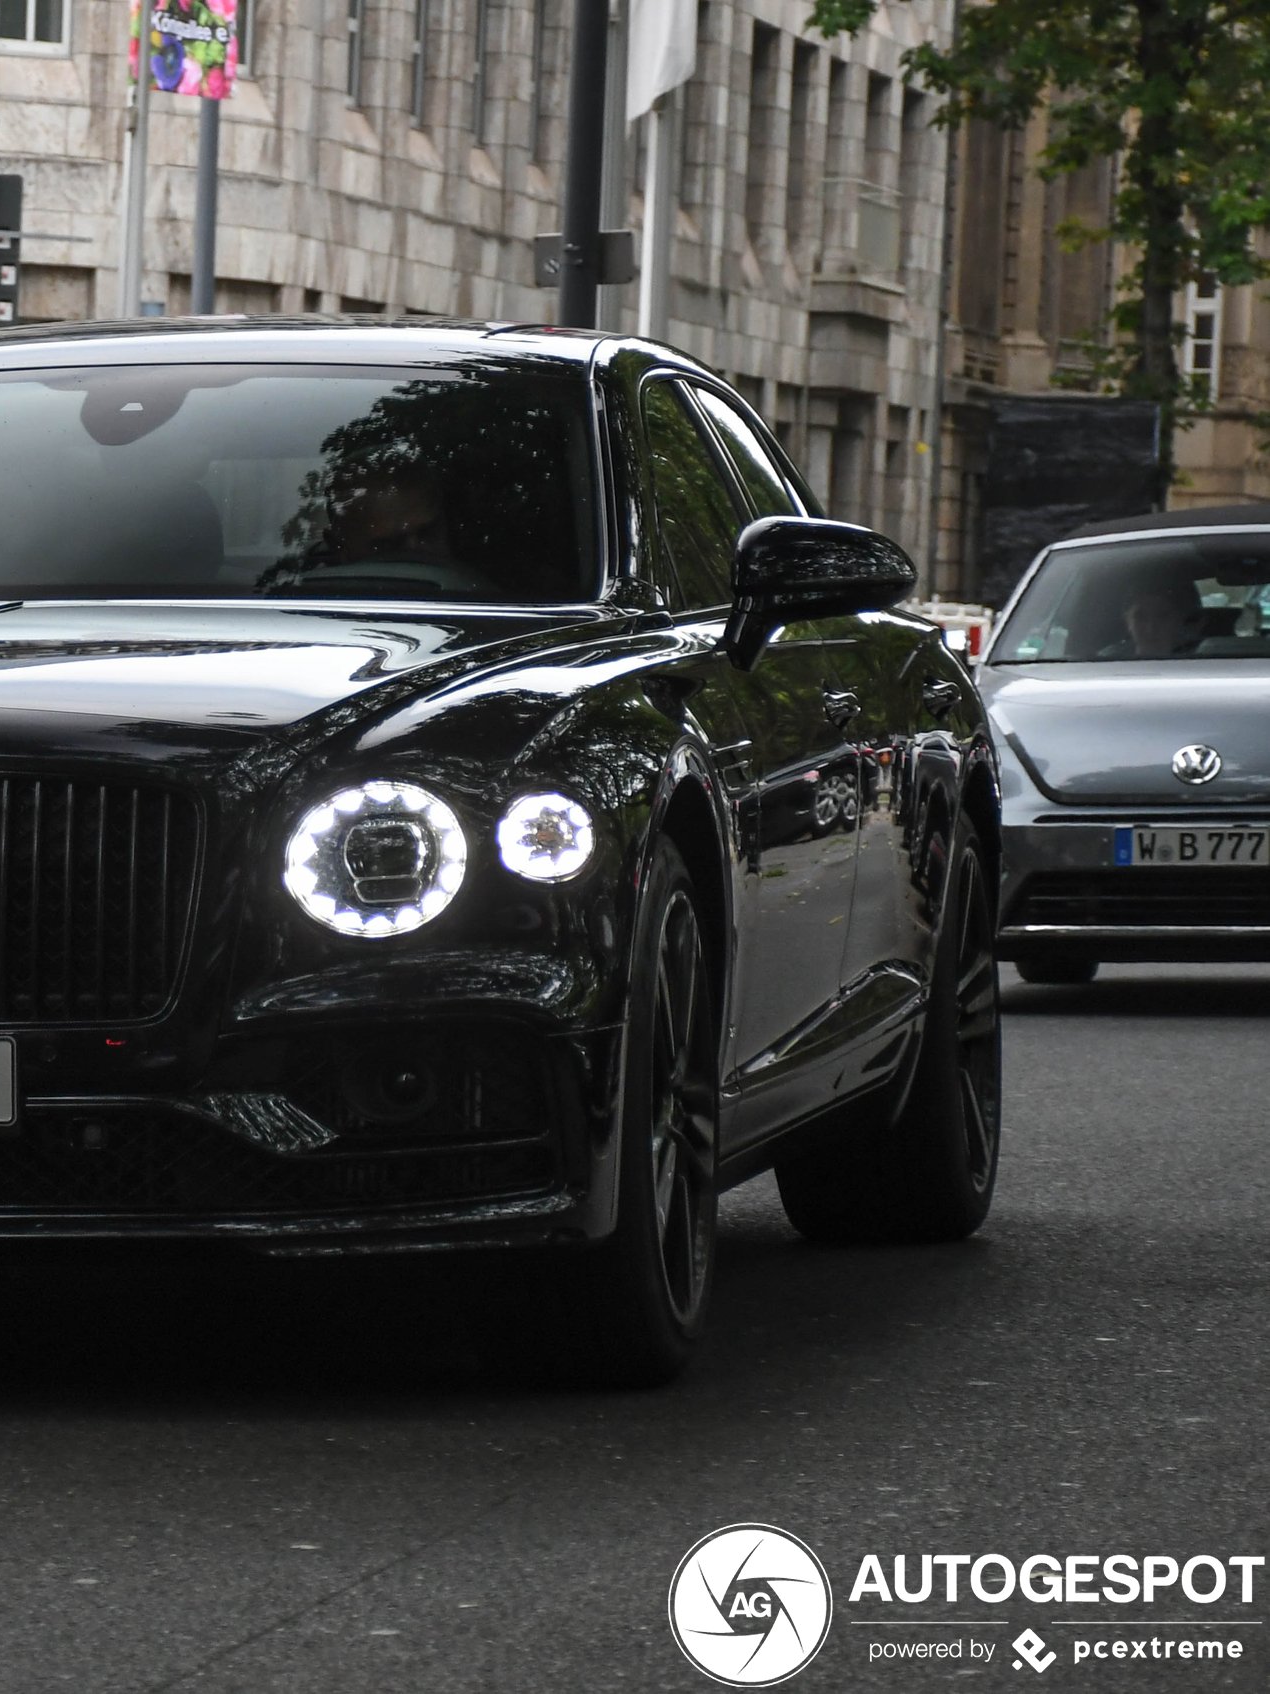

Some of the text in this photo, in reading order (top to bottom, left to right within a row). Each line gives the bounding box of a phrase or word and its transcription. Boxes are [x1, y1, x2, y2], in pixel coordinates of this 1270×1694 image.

[1138, 833, 1265, 860] W B 777
